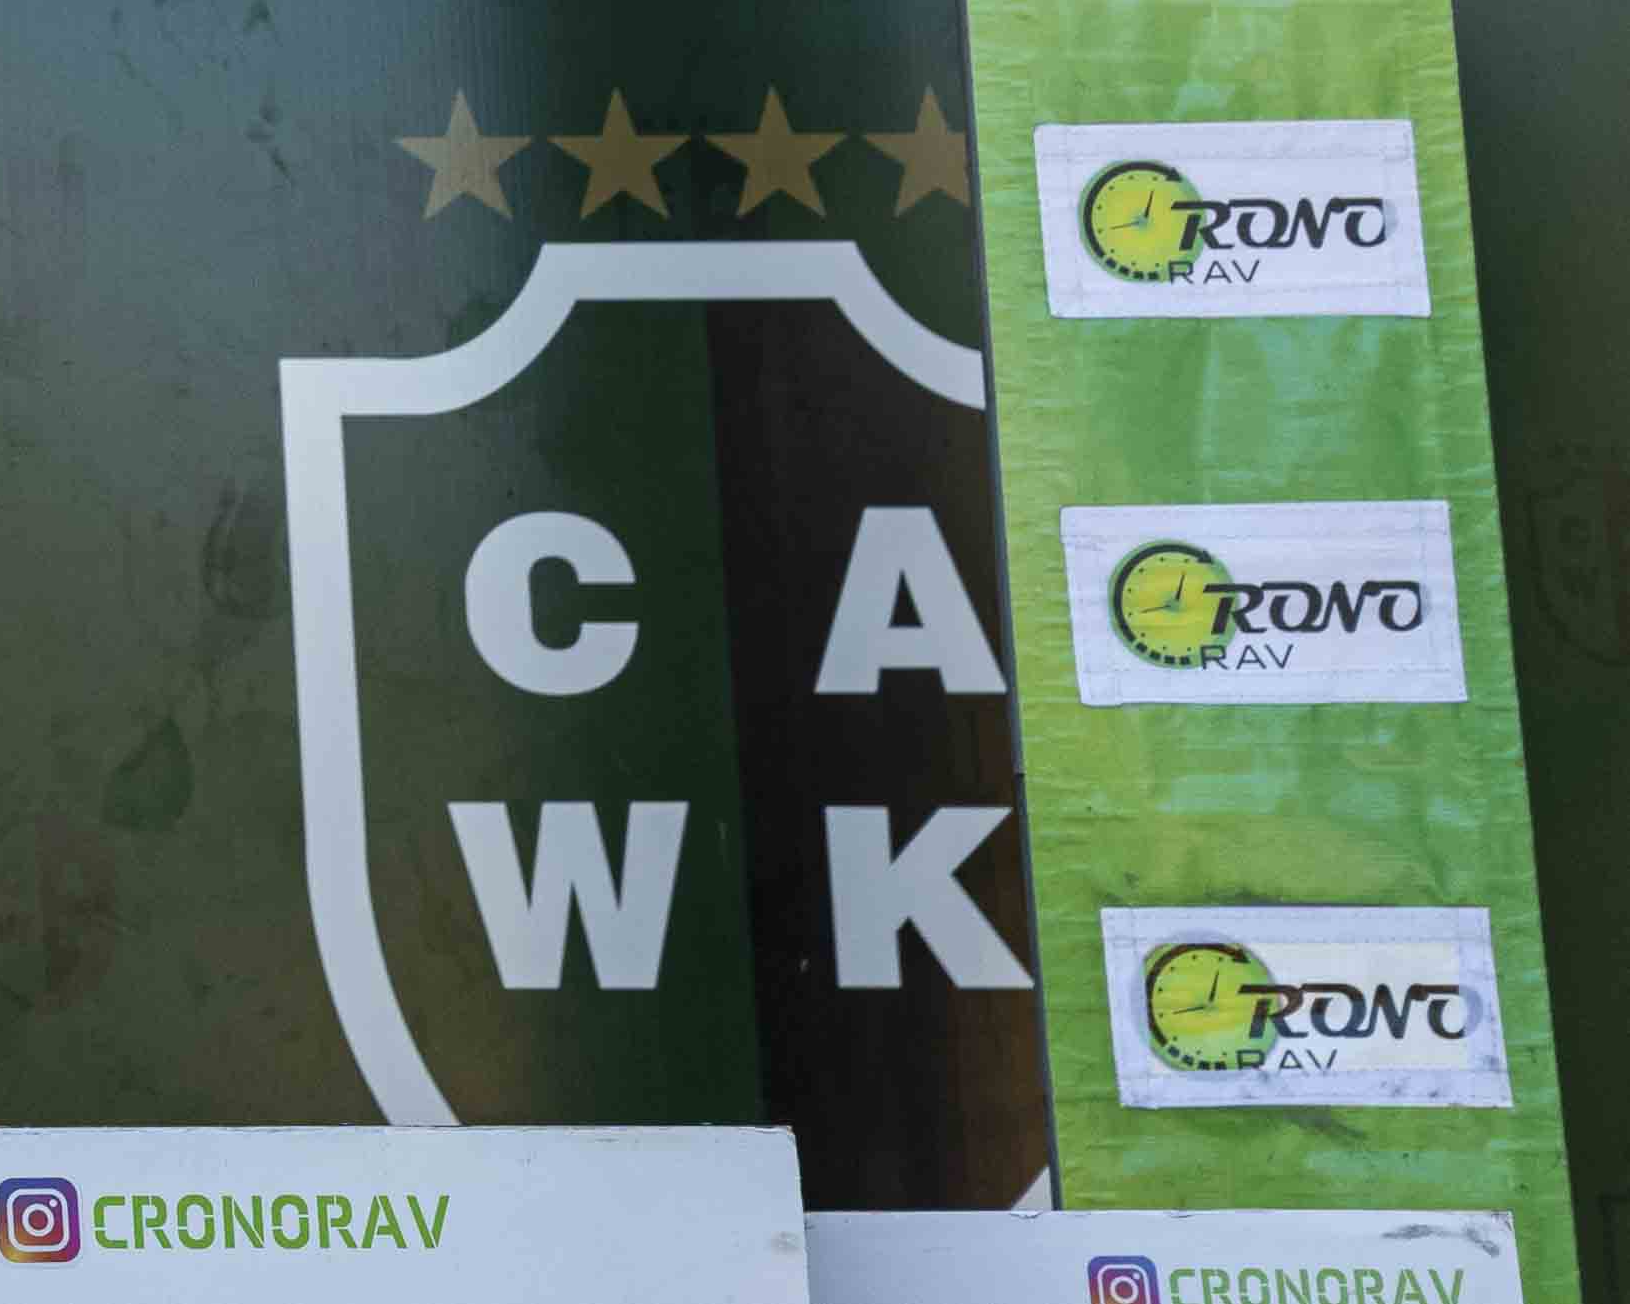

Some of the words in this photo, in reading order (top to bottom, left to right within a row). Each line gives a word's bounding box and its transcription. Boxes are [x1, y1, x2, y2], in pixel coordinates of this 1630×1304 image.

[1167, 259, 1261, 285] RAV
[1200, 644, 1294, 670] RAV
[92, 1194, 451, 1251] CRONORAV
[1169, 1267, 1466, 1304] CRONORAV
